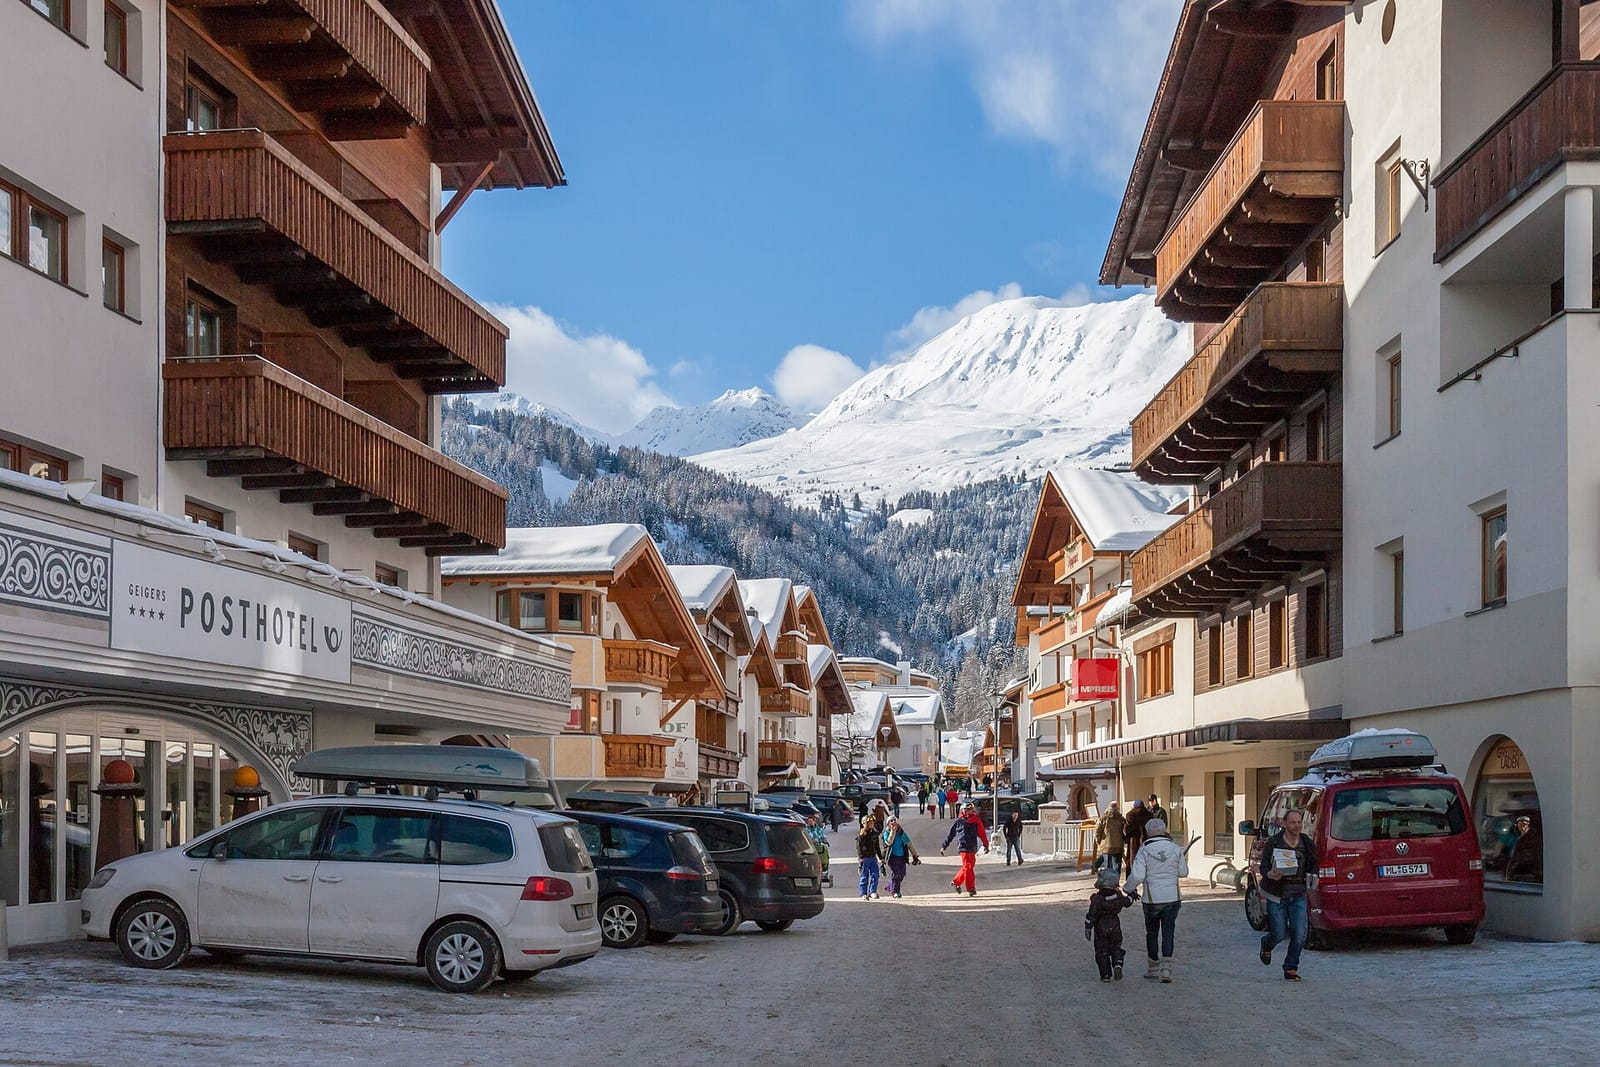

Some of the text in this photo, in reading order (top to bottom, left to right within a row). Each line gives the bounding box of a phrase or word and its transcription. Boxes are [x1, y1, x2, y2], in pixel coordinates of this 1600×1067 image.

[128, 583, 166, 602] GEIGERS
[180, 587, 318, 653] POSTHOTEL
[1080, 685, 1116, 693] MPREIS
